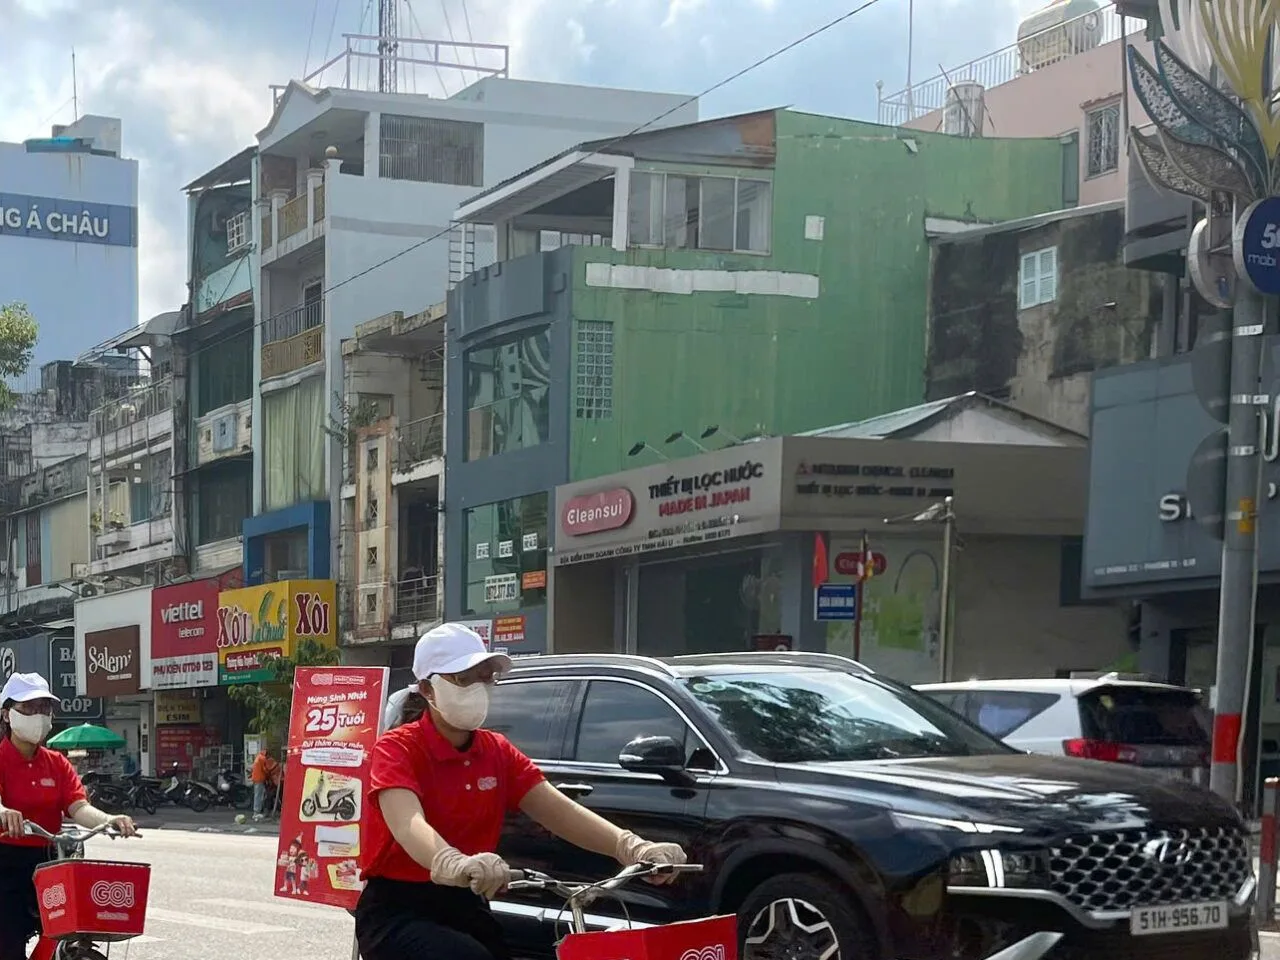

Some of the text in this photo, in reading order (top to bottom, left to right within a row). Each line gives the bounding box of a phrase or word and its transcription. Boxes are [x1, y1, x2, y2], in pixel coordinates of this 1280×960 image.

[26, 204, 42, 229] Á
[46, 210, 108, 238] CHÂU
[649, 475, 680, 499] THIẾT
[694, 471, 722, 491] LỌC
[724, 461, 763, 480] NƯỚC
[567, 498, 622, 525] Cleansui
[659, 499, 694, 516] MADE
[708, 487, 750, 508] JAPAN
[161, 600, 204, 624] viettel
[179, 627, 205, 638] telecom
[306, 707, 336, 732] 25
[91, 880, 135, 908] GO!
[1139, 905, 1221, 930] 51H-956.70
